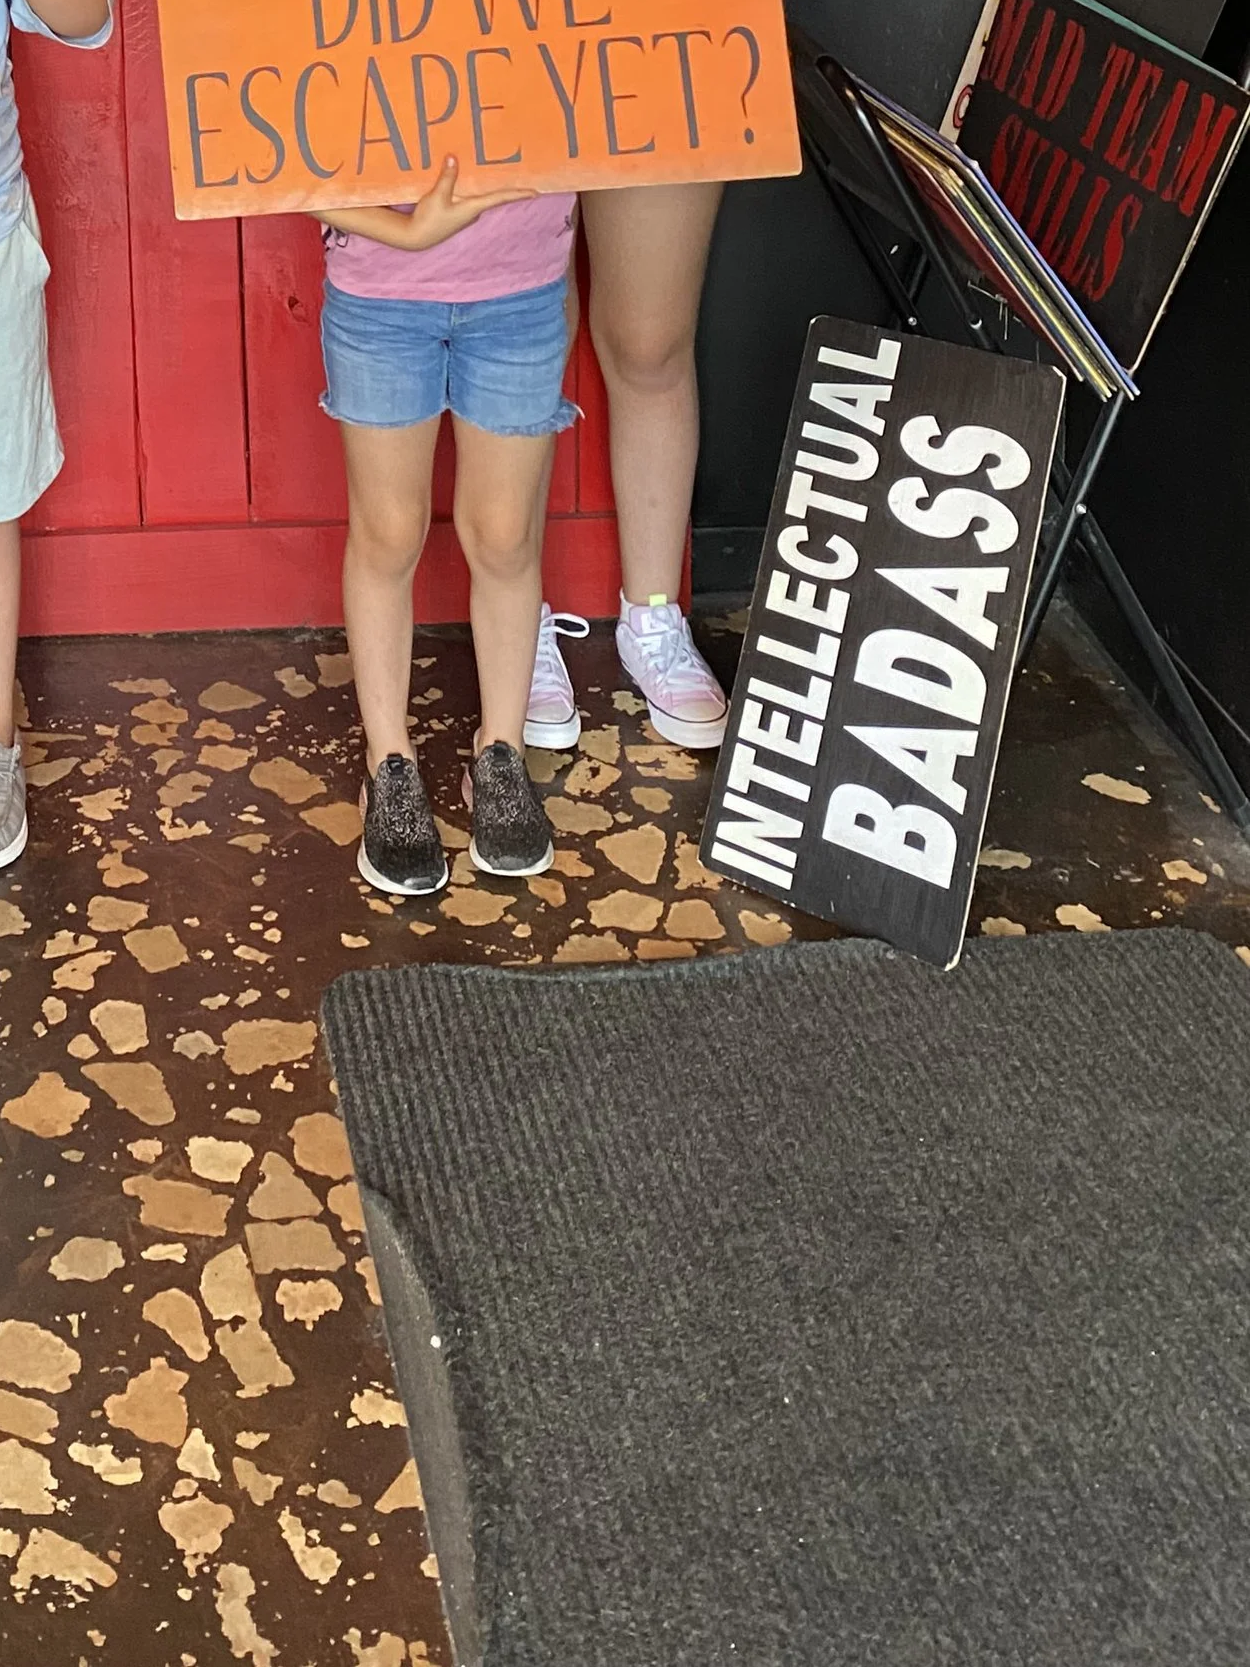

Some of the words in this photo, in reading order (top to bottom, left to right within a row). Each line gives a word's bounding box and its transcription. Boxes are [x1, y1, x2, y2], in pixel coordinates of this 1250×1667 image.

[185, 47, 523, 189] ESCAPE
[538, 25, 762, 160] YET?
[1080, 41, 1237, 218] TEAM
[710, 337, 903, 891] INTELLECTUAL
[821, 414, 1032, 890] BADASS
